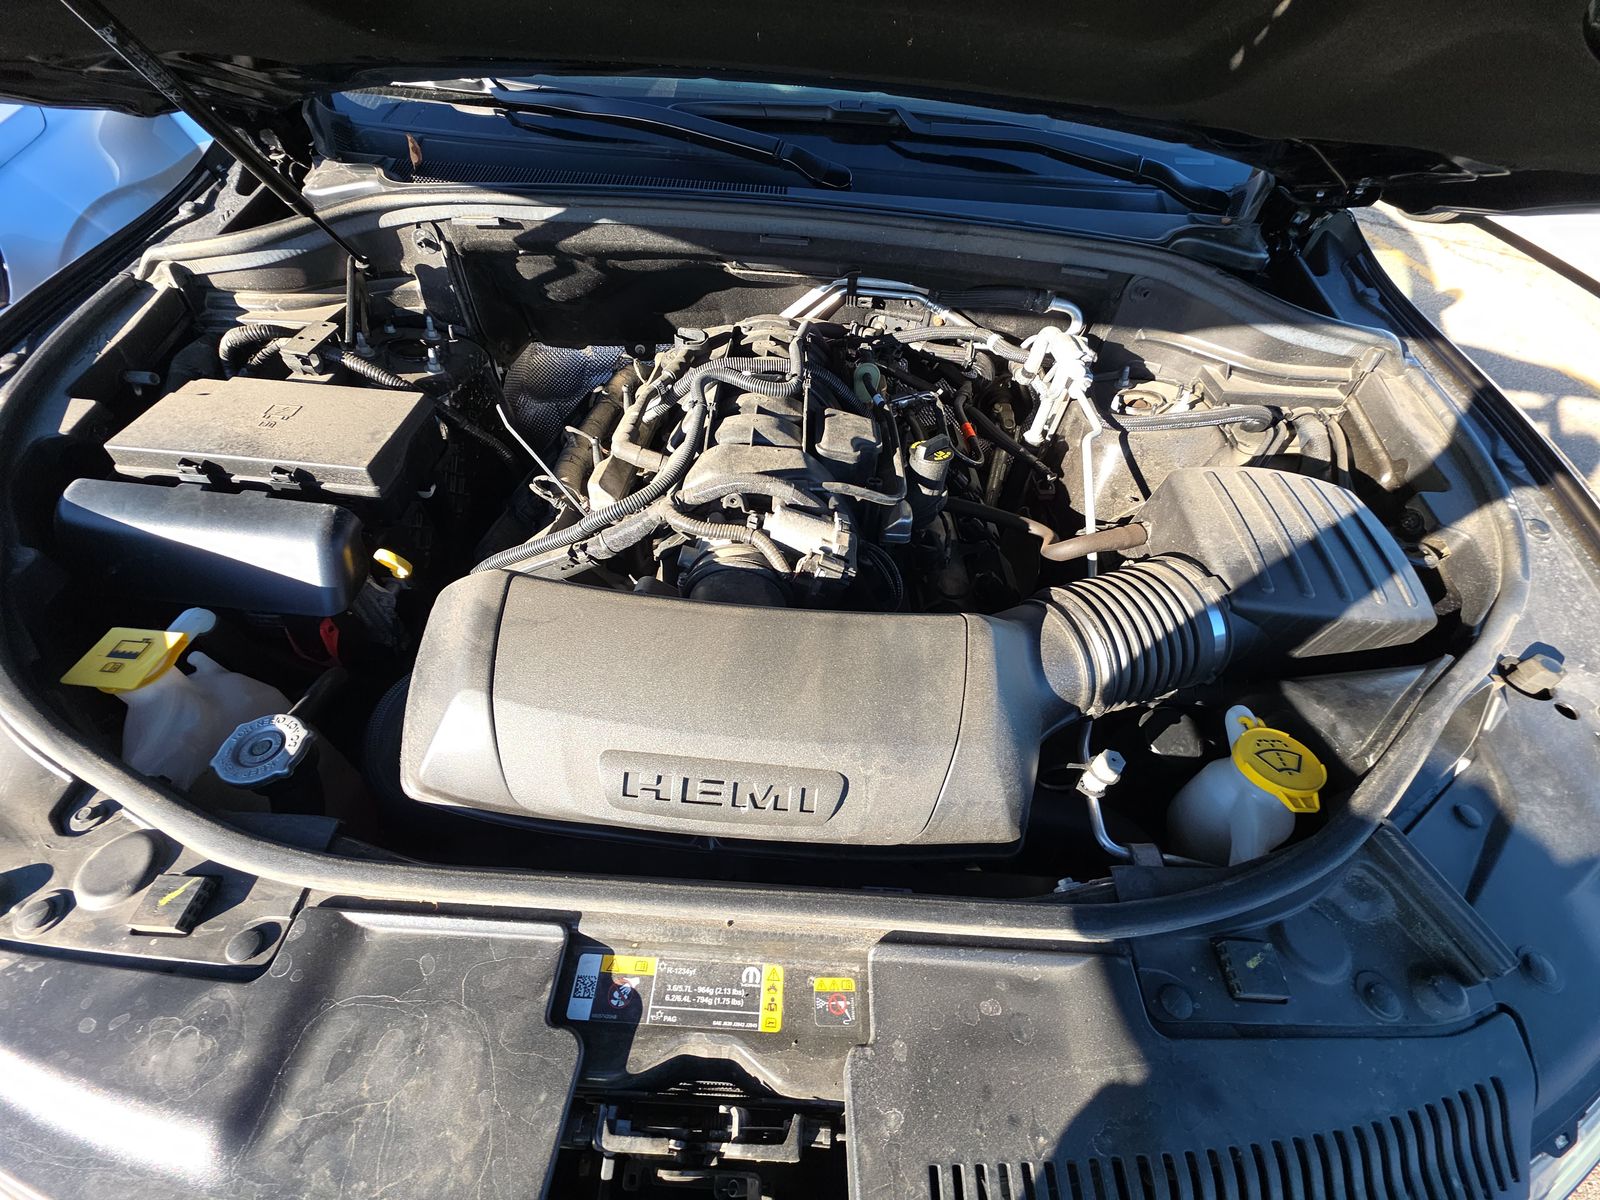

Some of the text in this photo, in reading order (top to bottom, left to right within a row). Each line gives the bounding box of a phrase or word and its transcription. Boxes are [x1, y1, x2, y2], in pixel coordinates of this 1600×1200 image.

[621, 771, 819, 814] HEMI
[666, 967, 697, 977] R-1234yf
[715, 987, 731, 996] (2.13
[714, 997, 731, 1006] (1.75
[663, 1015, 677, 1023] PAG
